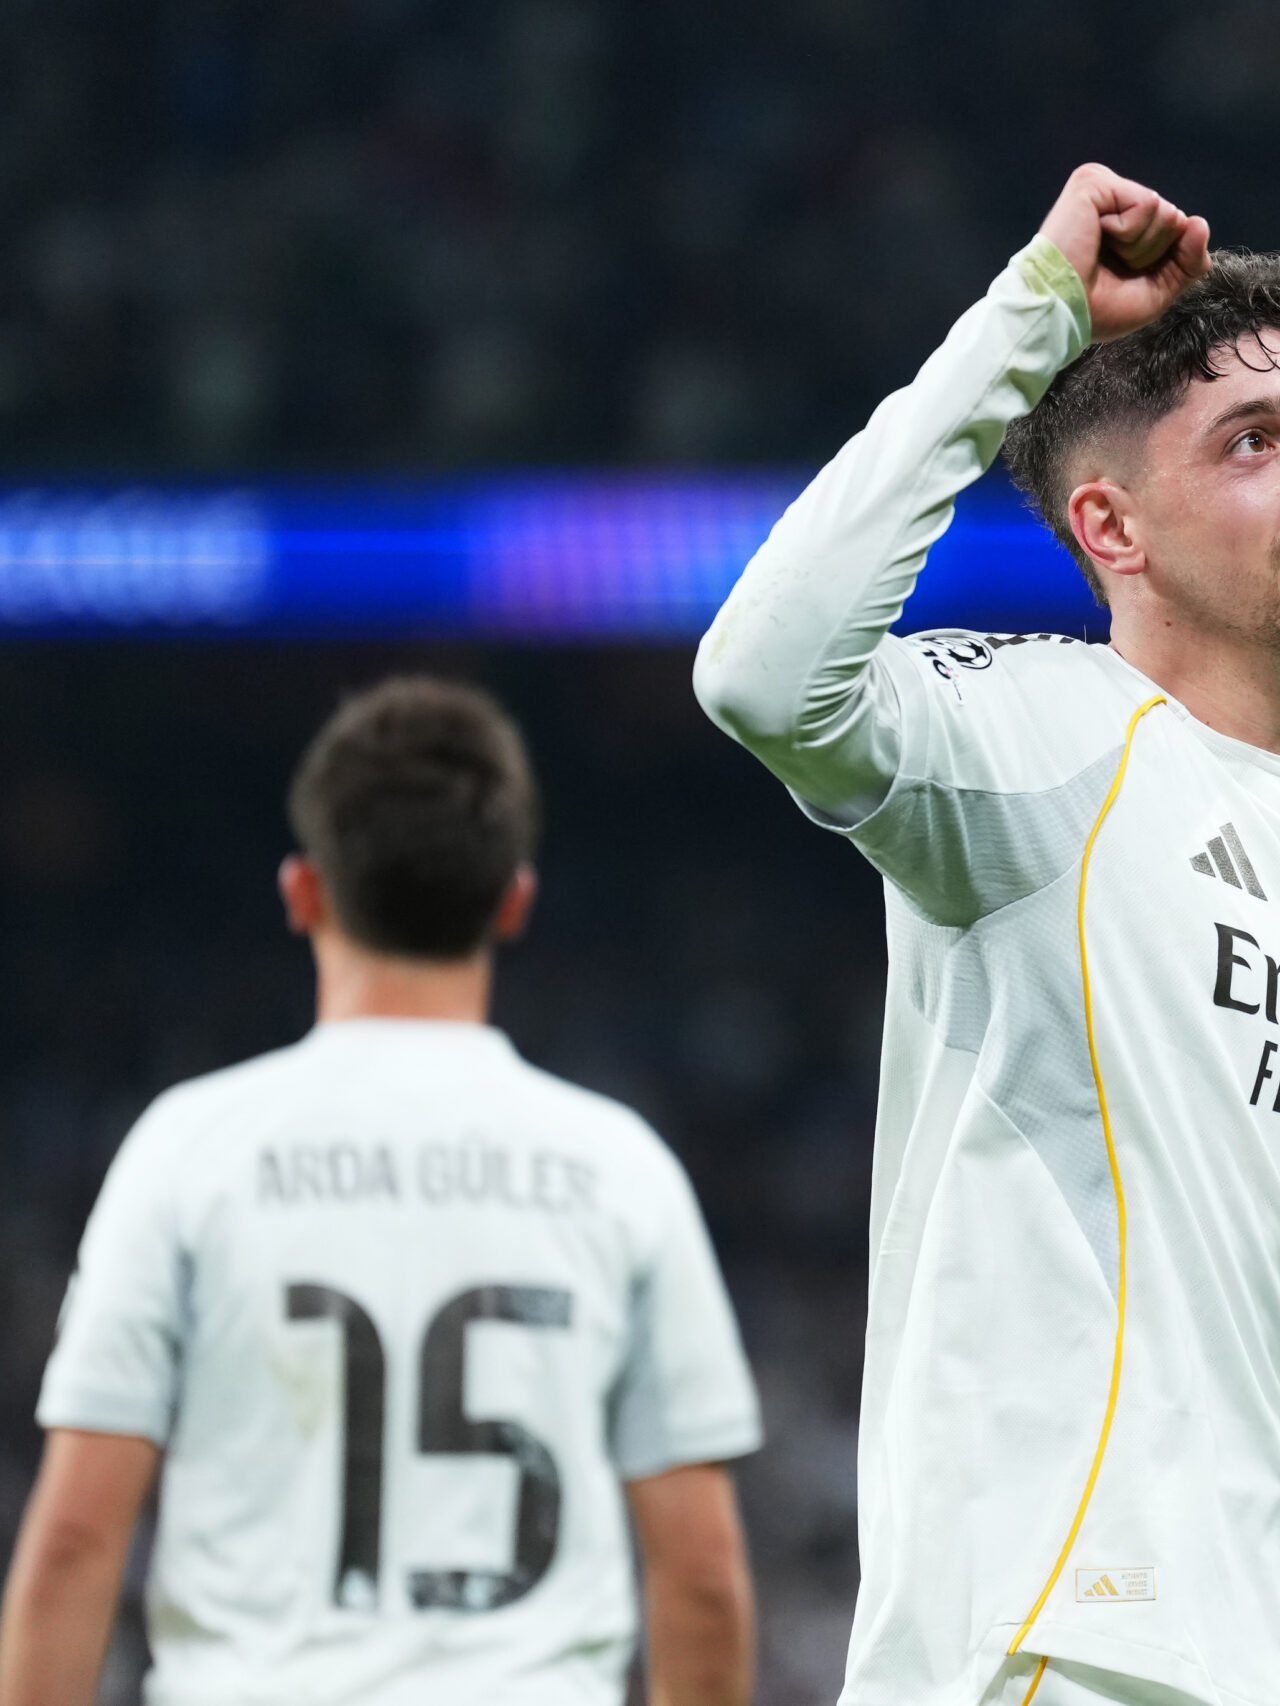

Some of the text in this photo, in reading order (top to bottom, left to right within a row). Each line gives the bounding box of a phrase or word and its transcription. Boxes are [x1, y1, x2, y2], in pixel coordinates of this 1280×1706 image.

[256, 1131, 601, 1216] ARDA GÜLER
[284, 1282, 574, 1613] 15
